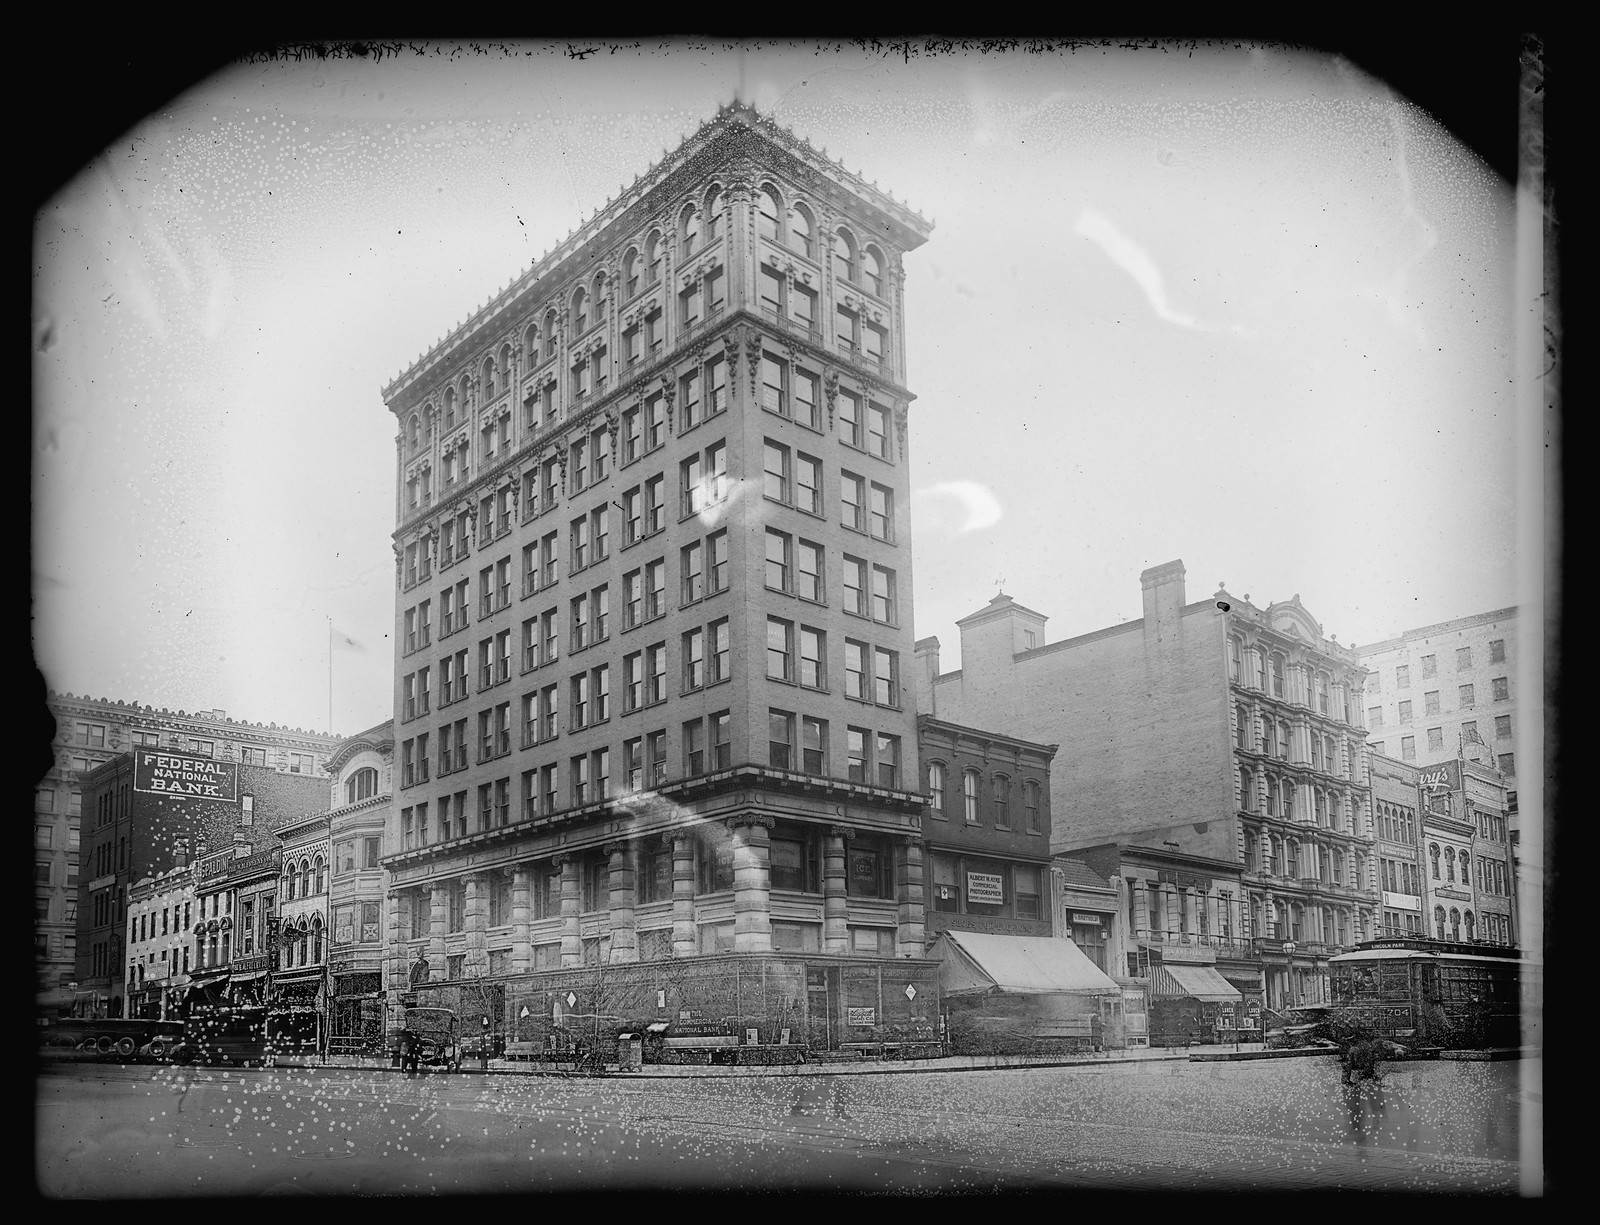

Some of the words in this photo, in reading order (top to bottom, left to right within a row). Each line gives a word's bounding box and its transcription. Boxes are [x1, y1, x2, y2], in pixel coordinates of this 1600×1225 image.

[144, 754, 227, 776] FEDERAL
[153, 768, 217, 784] NATIONAL
[150, 777, 224, 798] BANK.
[969, 874, 986, 882] ALBERT
[973, 882, 998, 890] COMMERCIAL
[969, 888, 1002, 897] PHOTOGRAPHER
[703, 1026, 720, 1034] BANK
